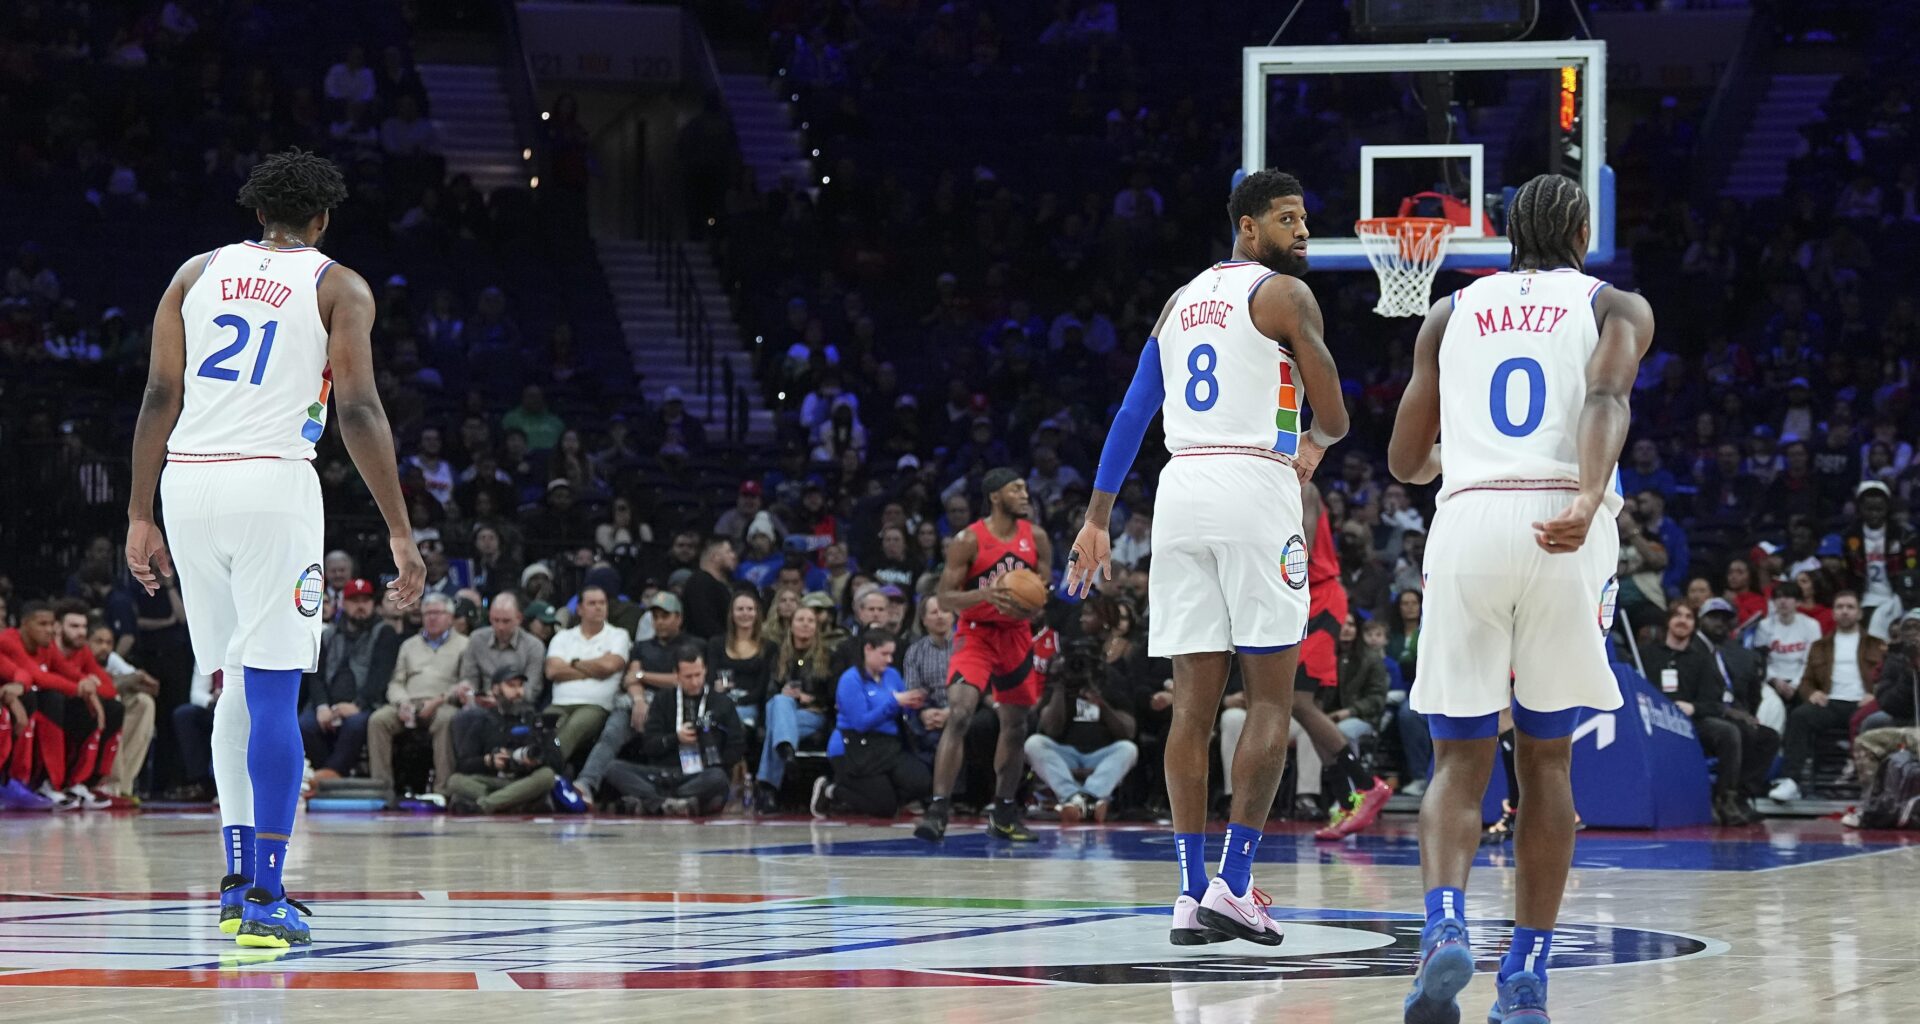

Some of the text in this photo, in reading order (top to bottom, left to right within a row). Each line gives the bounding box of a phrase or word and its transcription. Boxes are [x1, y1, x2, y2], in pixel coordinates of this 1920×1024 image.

[221, 277, 292, 308] EMBIID
[1180, 300, 1233, 332] GEORGE
[1474, 305, 1568, 337] MAXEY
[197, 314, 278, 386] 21
[1185, 343, 1219, 412] 8
[1489, 357, 1546, 437] 0
